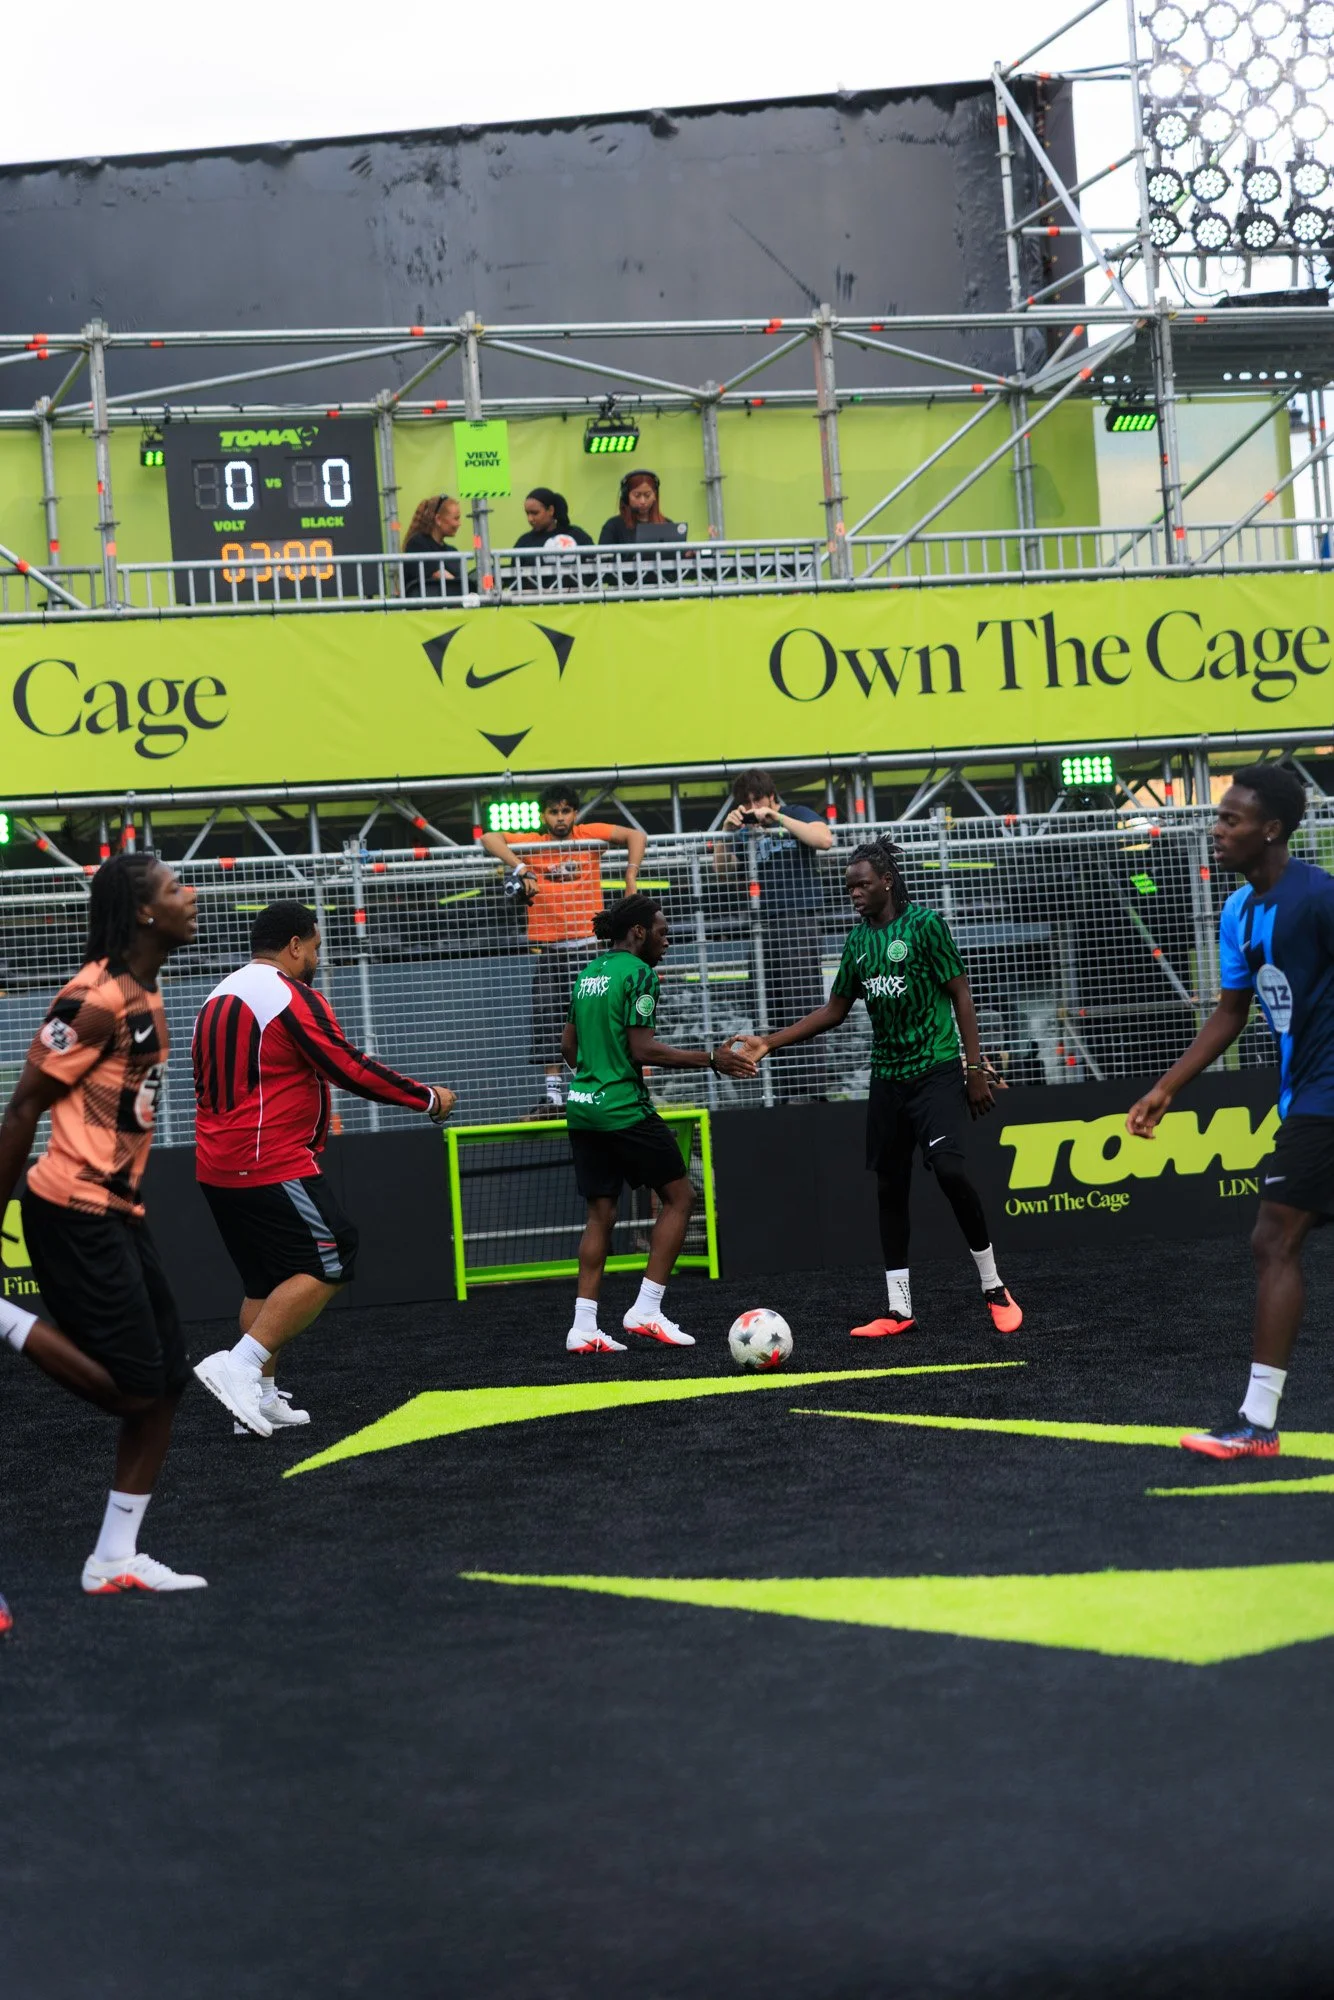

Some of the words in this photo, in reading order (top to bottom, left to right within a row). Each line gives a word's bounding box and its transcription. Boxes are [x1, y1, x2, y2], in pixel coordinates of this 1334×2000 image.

[219, 428, 302, 448] TOMA
[464, 459, 502, 468] POINT
[466, 451, 499, 459] VIEW
[224, 460, 255, 510] 0
[321, 458, 352, 507] 0
[213, 519, 247, 533] VOLT
[301, 515, 345, 529] BLACK
[768, 626, 968, 703] Own
[975, 609, 1134, 692] The
[1145, 608, 1333, 704] Cage
[11, 658, 229, 761] Cage
[1218, 1177, 1260, 1197] LDN
[1005, 1196, 1050, 1217] Own
[1050, 1191, 1086, 1212] The
[1086, 1190, 1131, 1213] Cage
